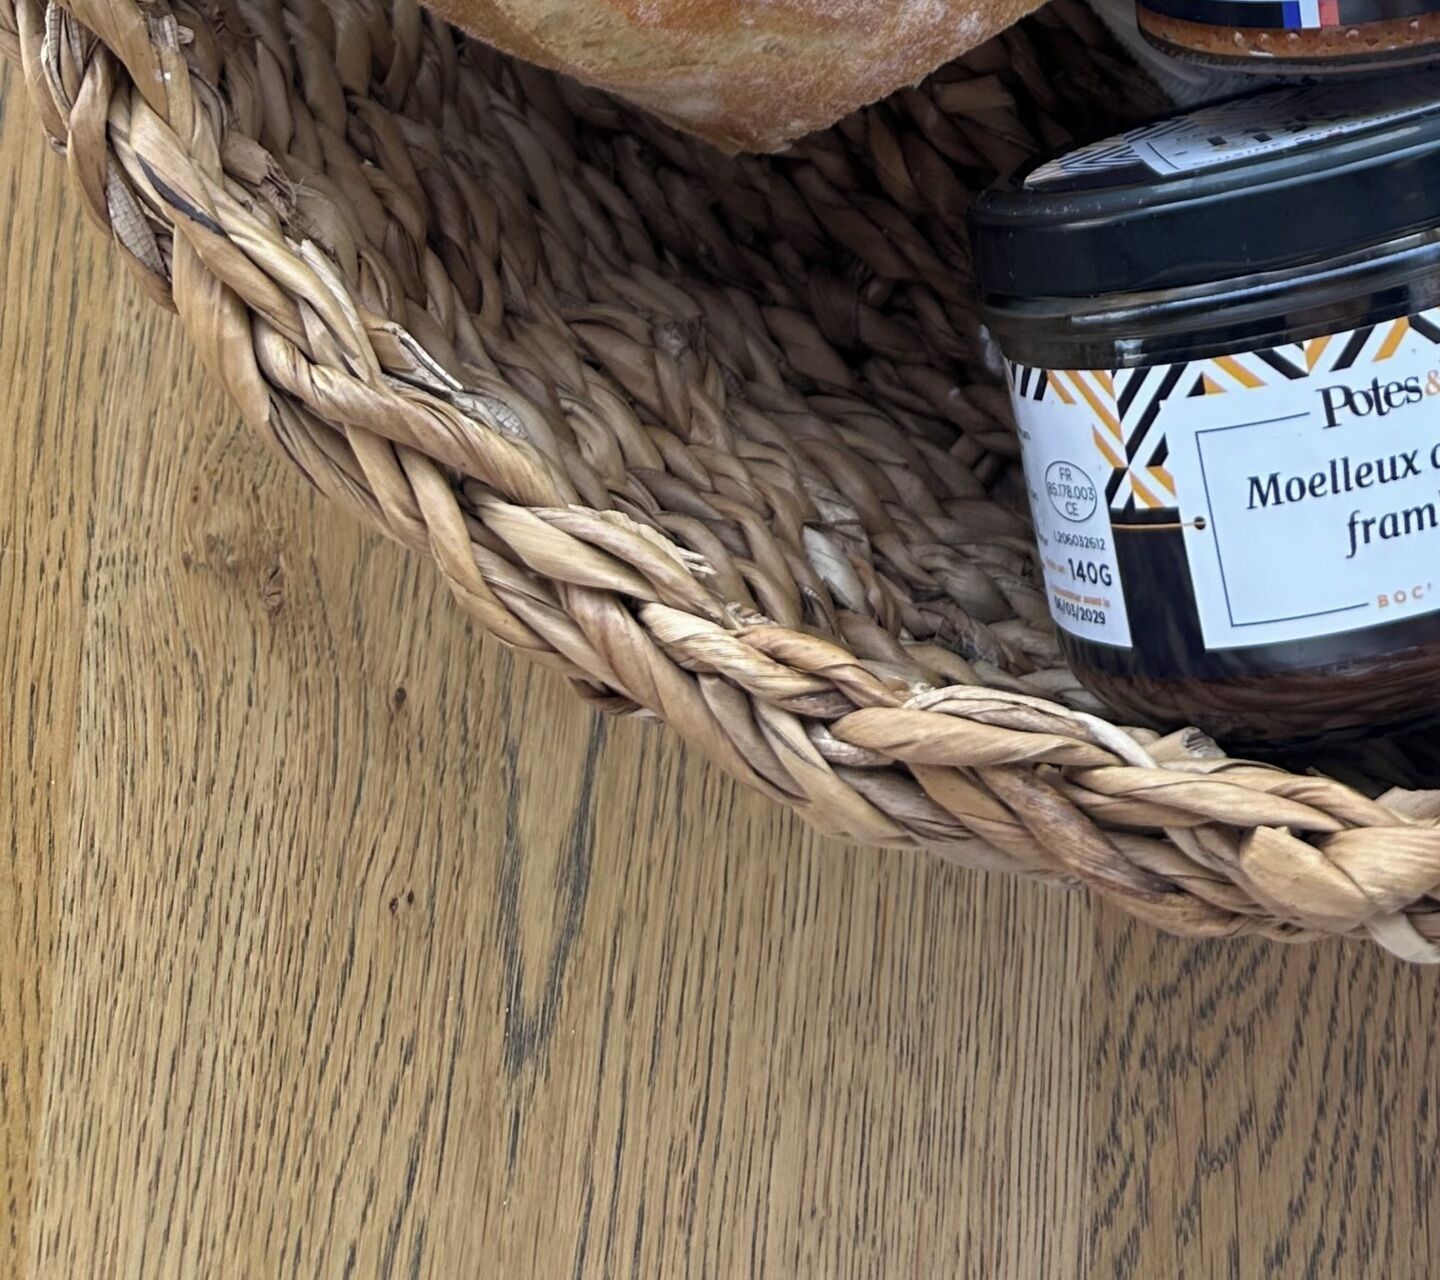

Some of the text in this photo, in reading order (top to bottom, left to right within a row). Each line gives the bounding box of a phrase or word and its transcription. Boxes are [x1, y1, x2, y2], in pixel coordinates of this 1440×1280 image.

[1059, 467, 1073, 482] FR
[1246, 452, 1421, 511] Moelleux
[1066, 501, 1079, 516] CE
[1068, 557, 1112, 586] 140G
